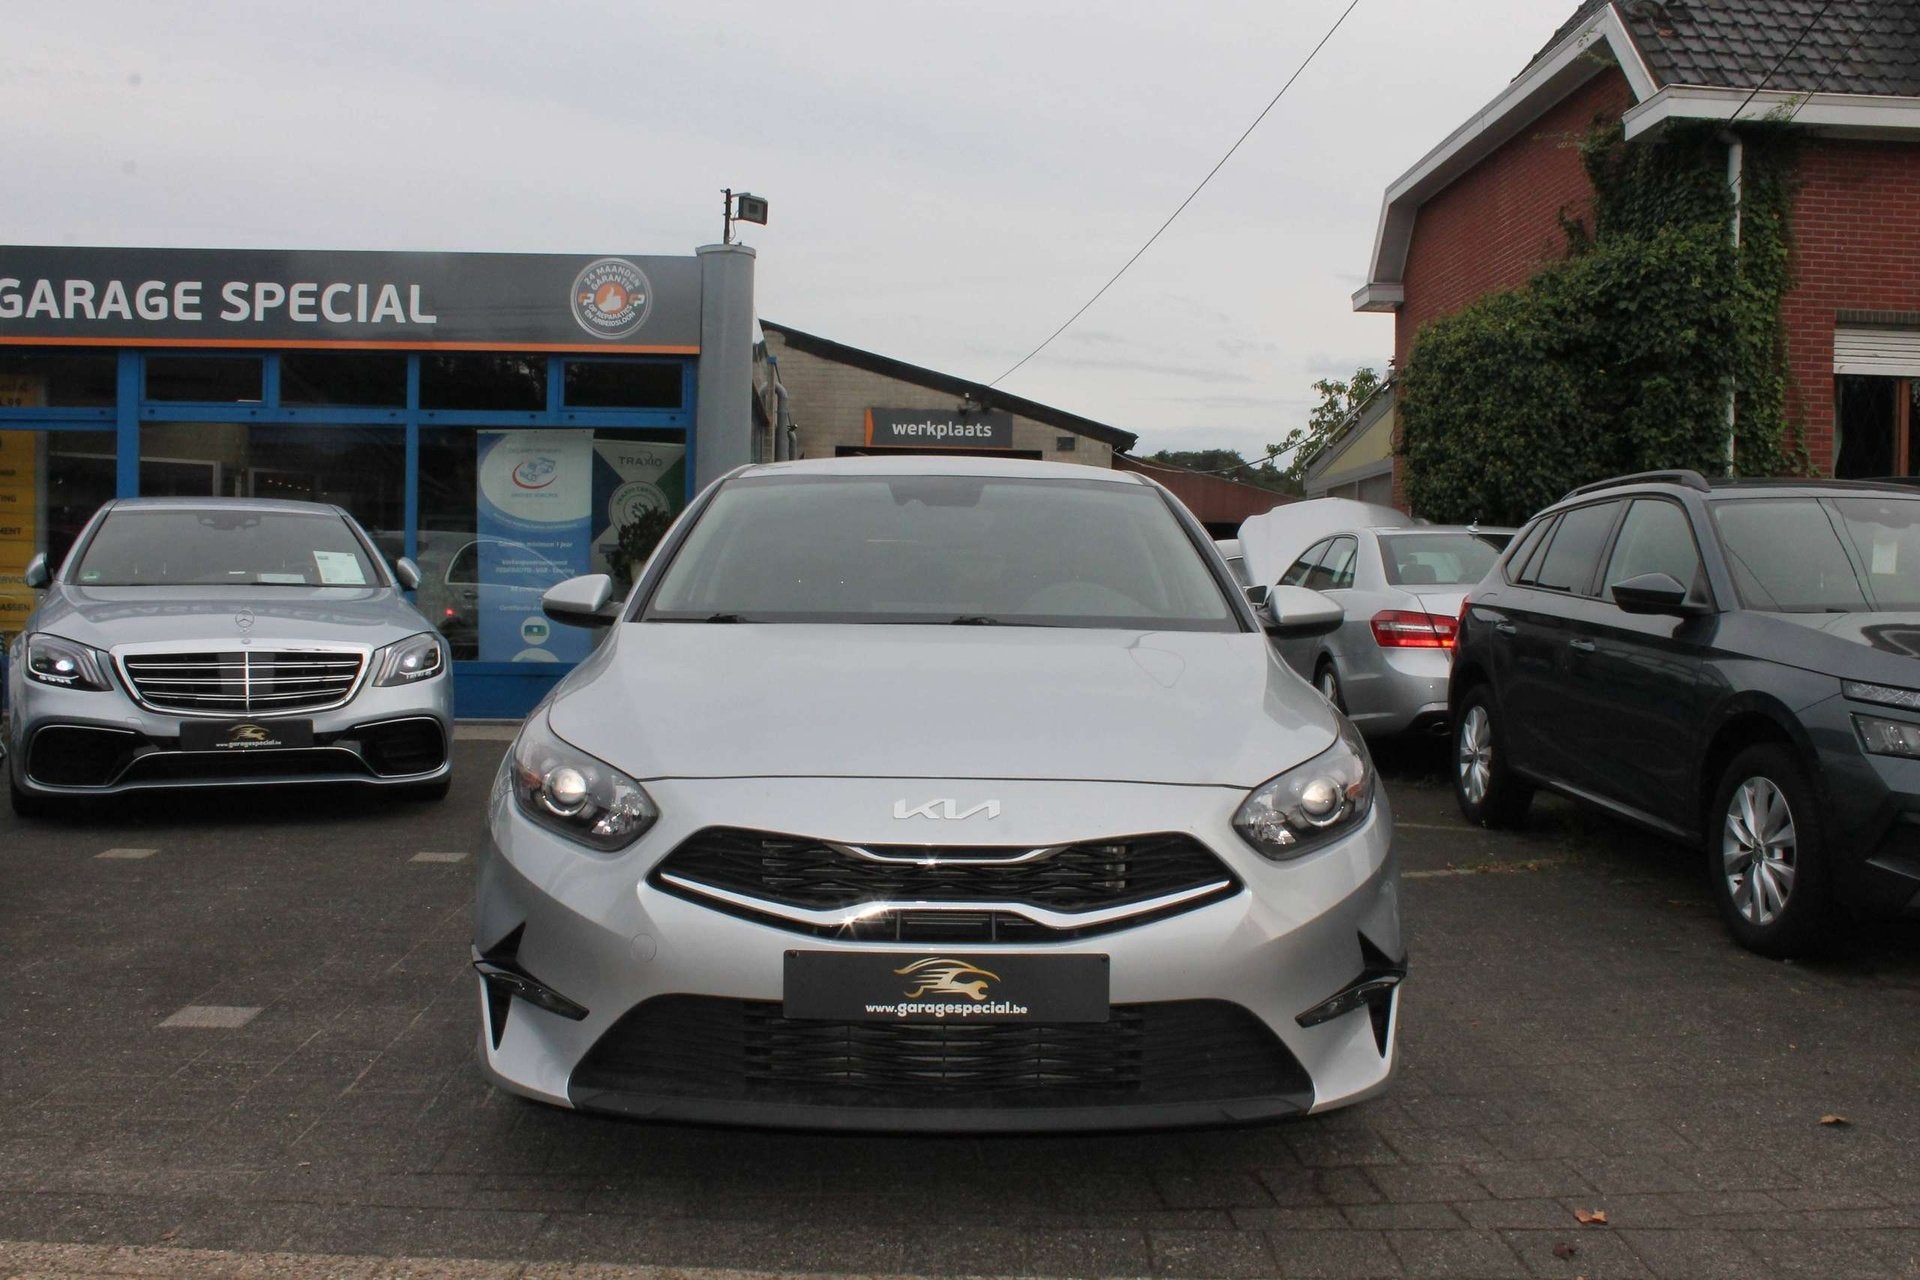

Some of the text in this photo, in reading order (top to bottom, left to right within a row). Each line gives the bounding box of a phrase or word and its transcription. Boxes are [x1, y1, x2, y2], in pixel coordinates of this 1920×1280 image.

[591, 274, 633, 292] GARANTIE
[596, 265, 640, 287] MAANDEN
[0, 278, 437, 323] GARAGE SPECIAL
[892, 421, 992, 440] werkplaats
[618, 455, 663, 468] TRAXIO
[215, 740, 282, 749] www.garagespecial.be
[893, 798, 1000, 821] KIA
[865, 1001, 1028, 1018] www.garagespecial.be
